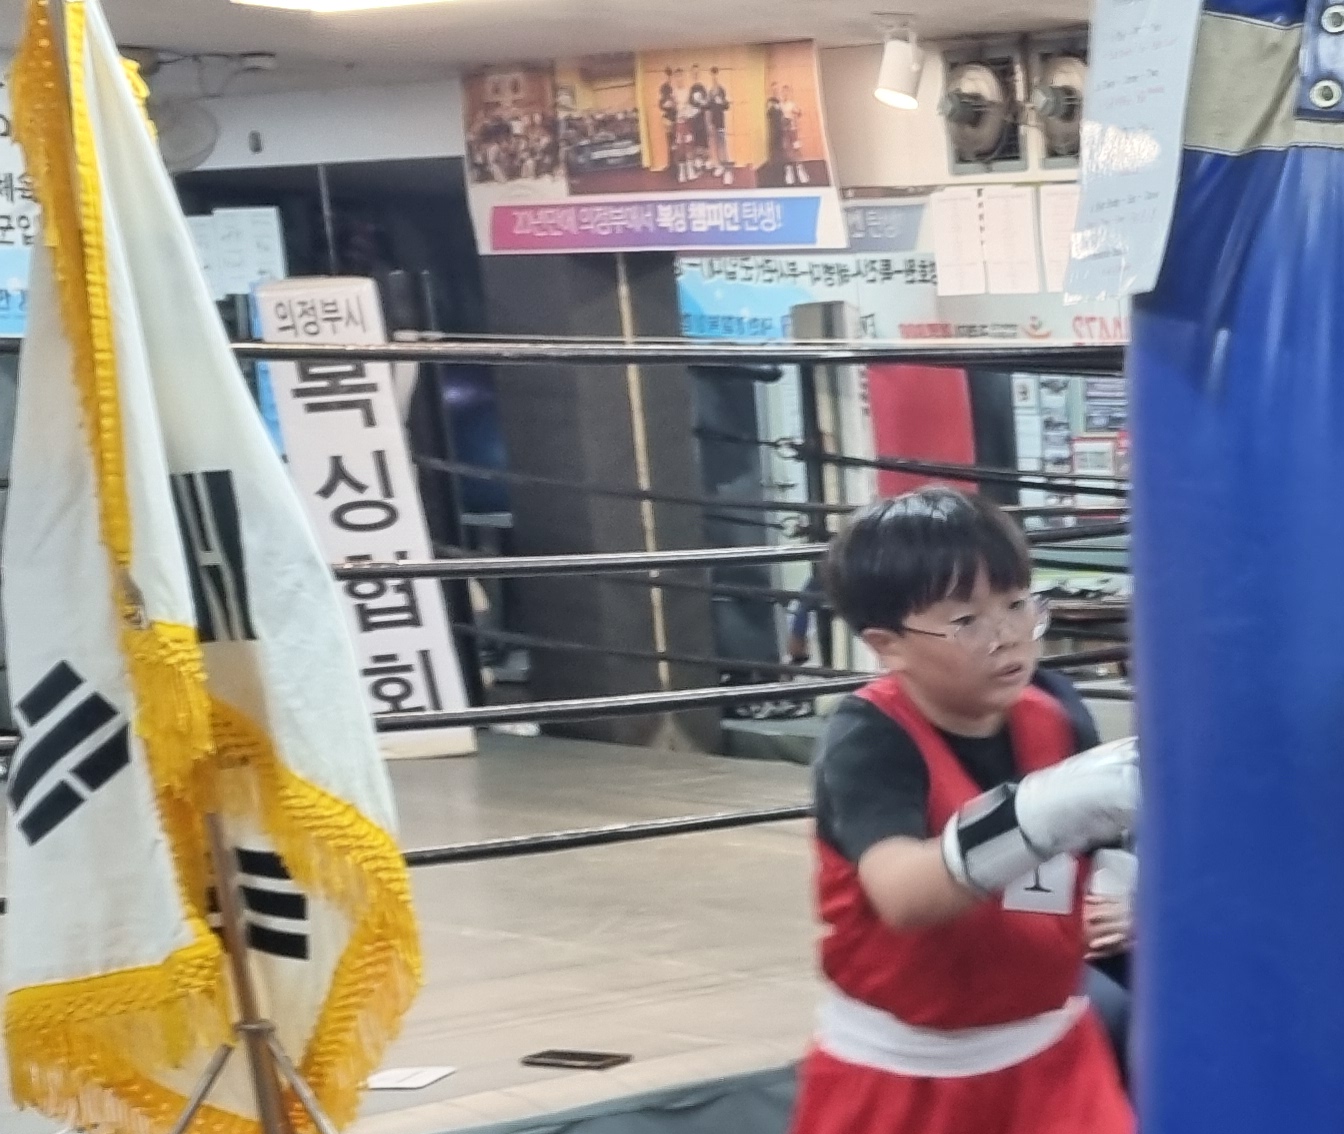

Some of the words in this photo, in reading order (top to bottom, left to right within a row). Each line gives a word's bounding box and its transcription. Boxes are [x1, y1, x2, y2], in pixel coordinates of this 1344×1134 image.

[689, 201, 741, 232] 챔피언
[743, 200, 784, 232] 탄생!
[273, 295, 368, 337] 의정부시
